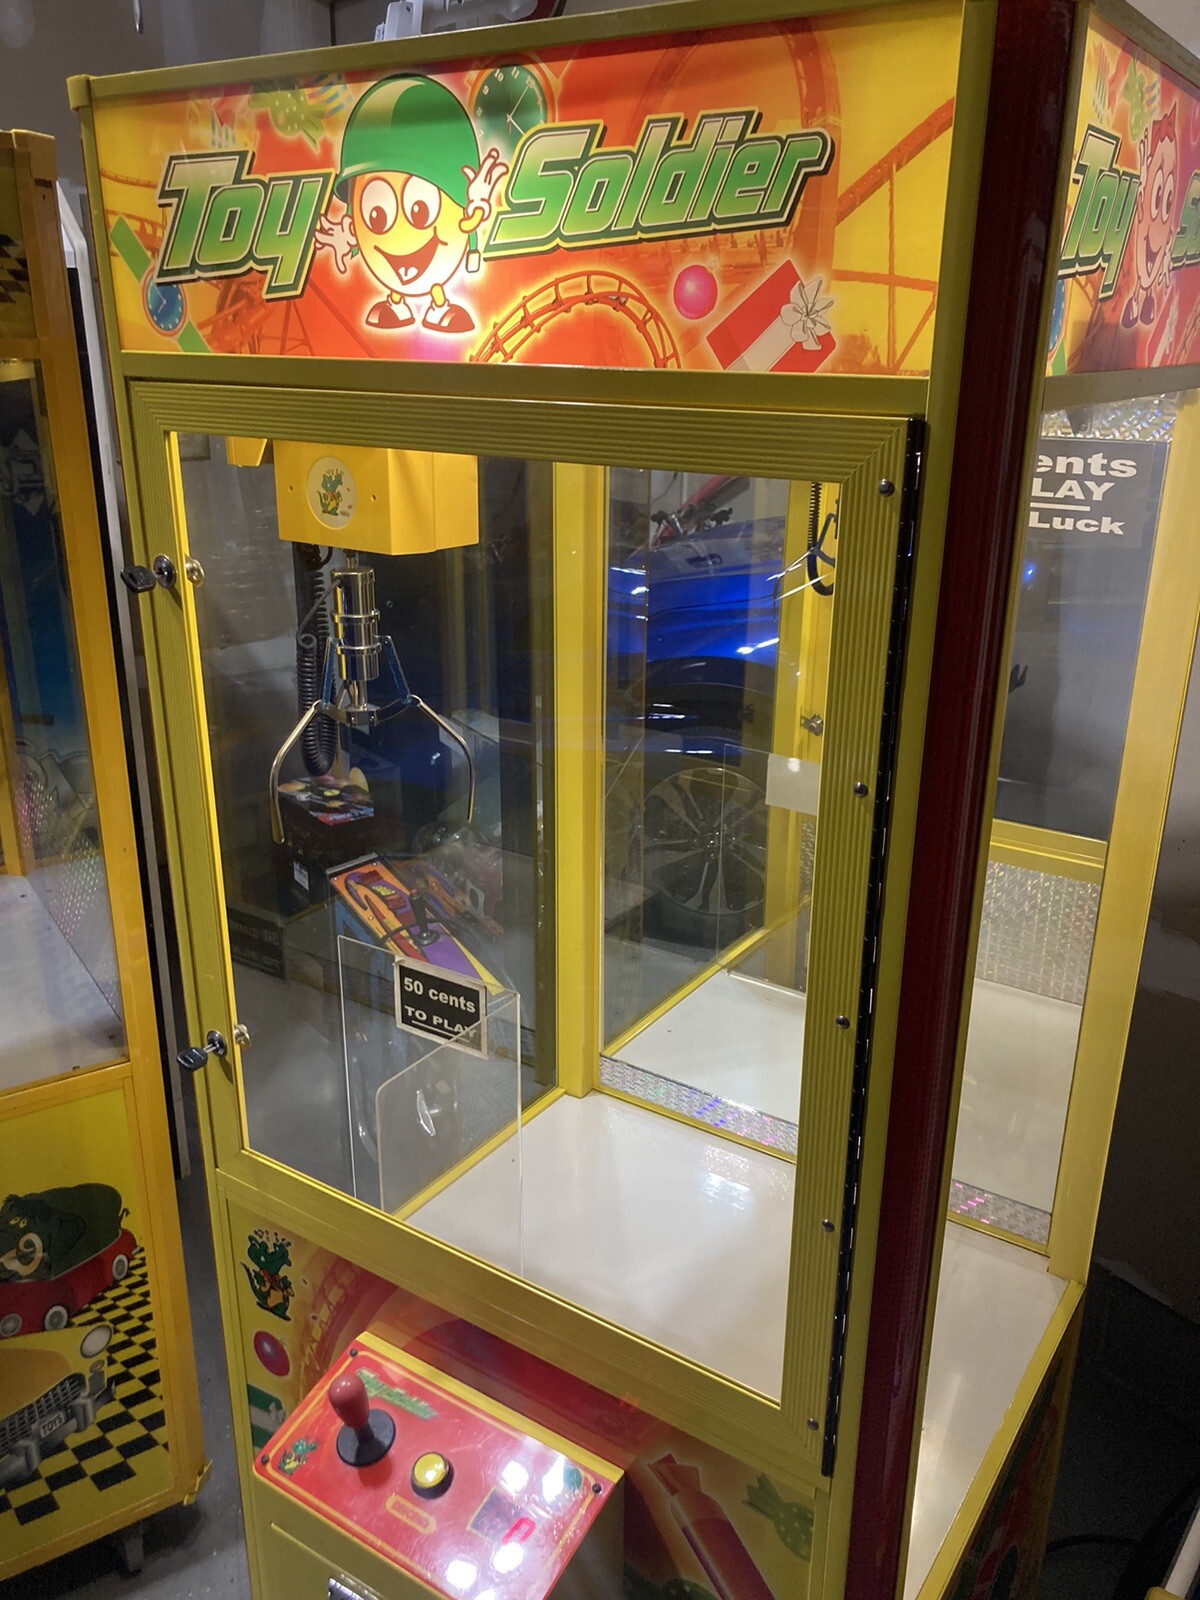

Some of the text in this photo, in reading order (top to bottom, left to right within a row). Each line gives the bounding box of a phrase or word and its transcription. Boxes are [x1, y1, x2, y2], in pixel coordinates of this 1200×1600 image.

[157, 107, 834, 299] Toy Soldier
[1058, 125, 1140, 299] Toy
[1028, 511, 1125, 535] Luck
[403, 976, 476, 1014] 50 cents
[404, 1005, 477, 1038] TO PLAY
